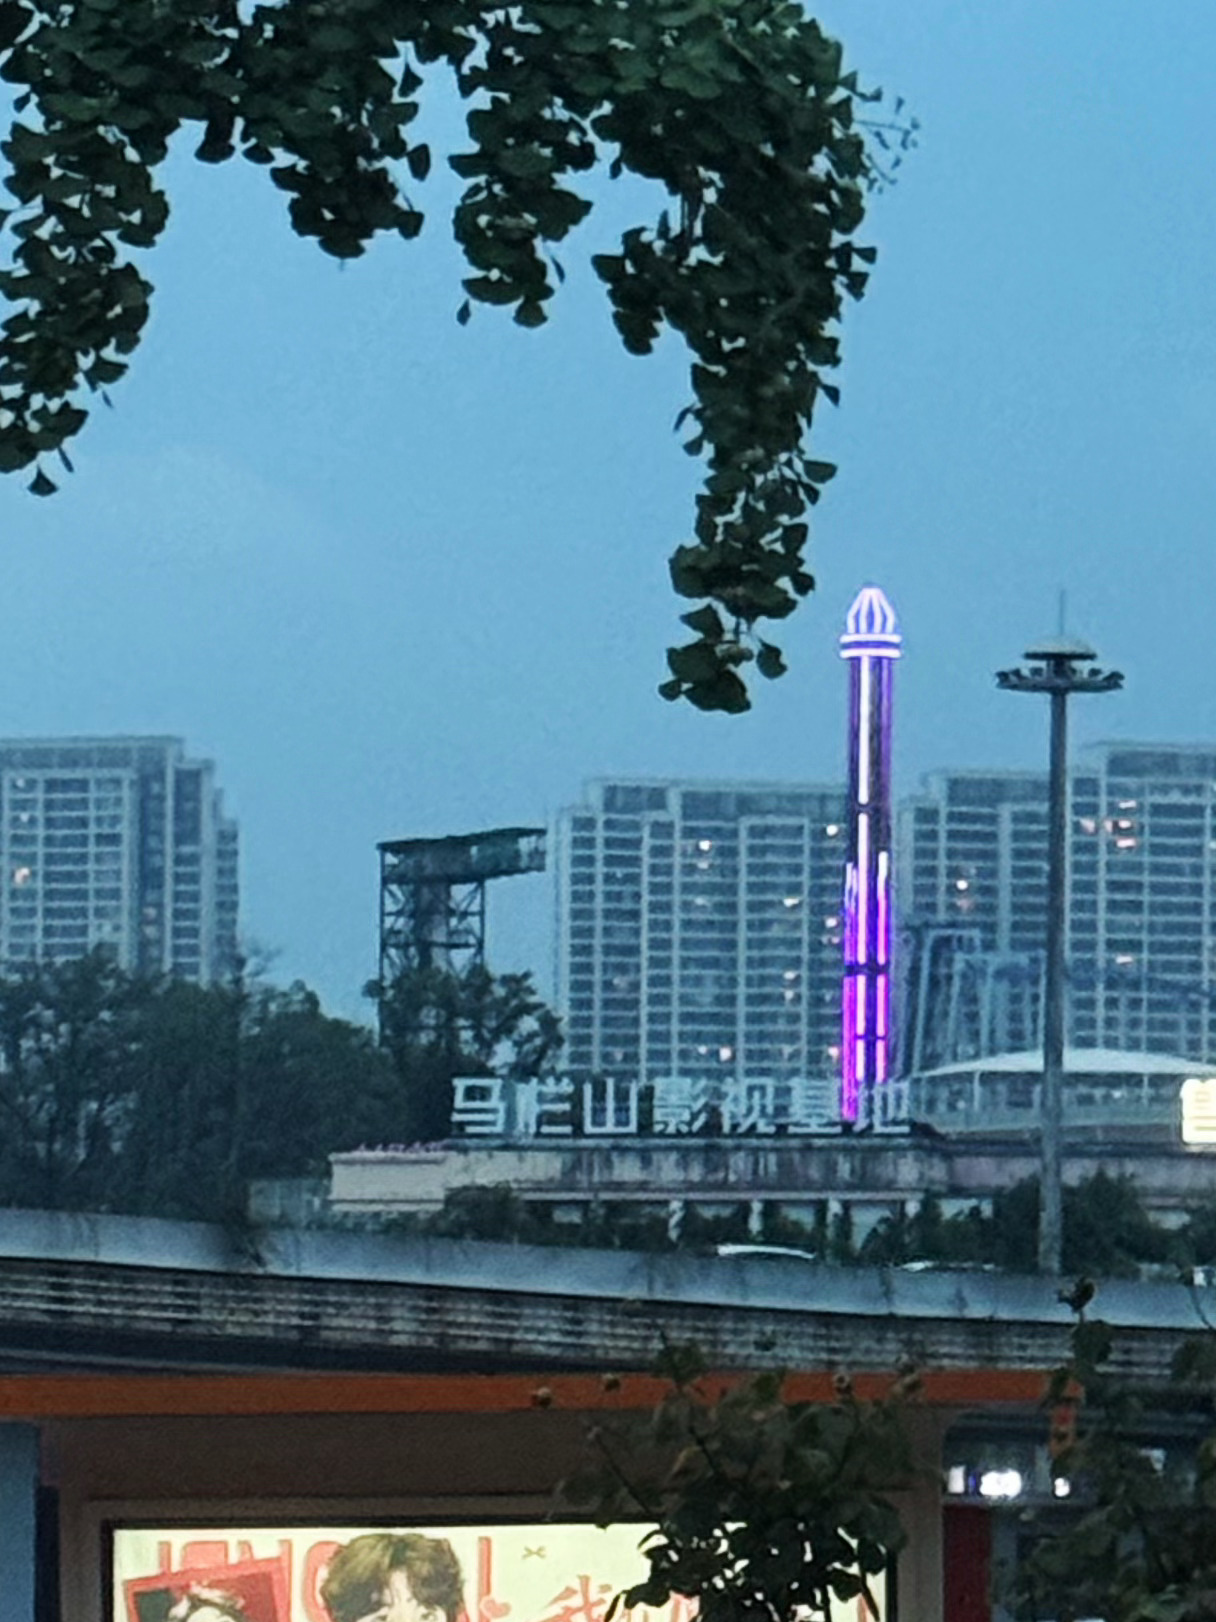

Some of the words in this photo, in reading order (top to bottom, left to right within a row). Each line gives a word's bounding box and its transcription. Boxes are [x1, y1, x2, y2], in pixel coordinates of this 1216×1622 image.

[451, 1077, 911, 1134] 马栏山影视基地
